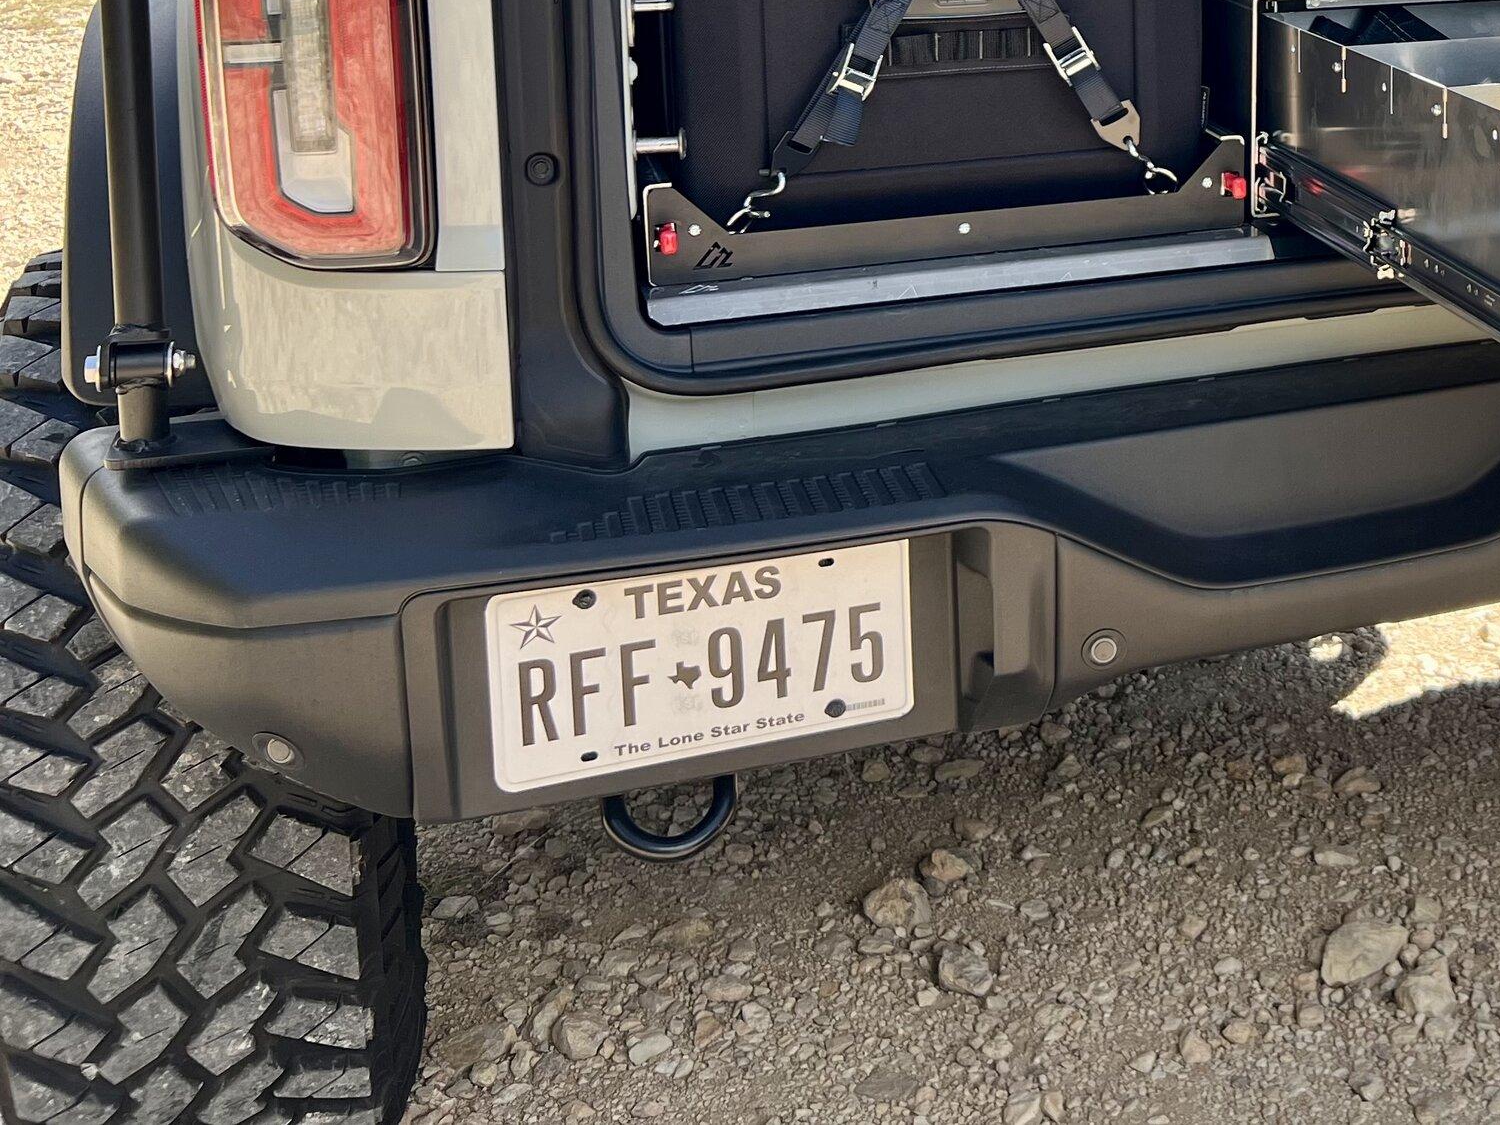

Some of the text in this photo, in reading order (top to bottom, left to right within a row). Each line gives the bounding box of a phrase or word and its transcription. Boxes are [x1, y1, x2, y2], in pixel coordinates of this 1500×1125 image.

[623, 565, 782, 619] TEXAS
[518, 601, 885, 747] RFF 9475
[614, 711, 805, 756] The Lone Star State
